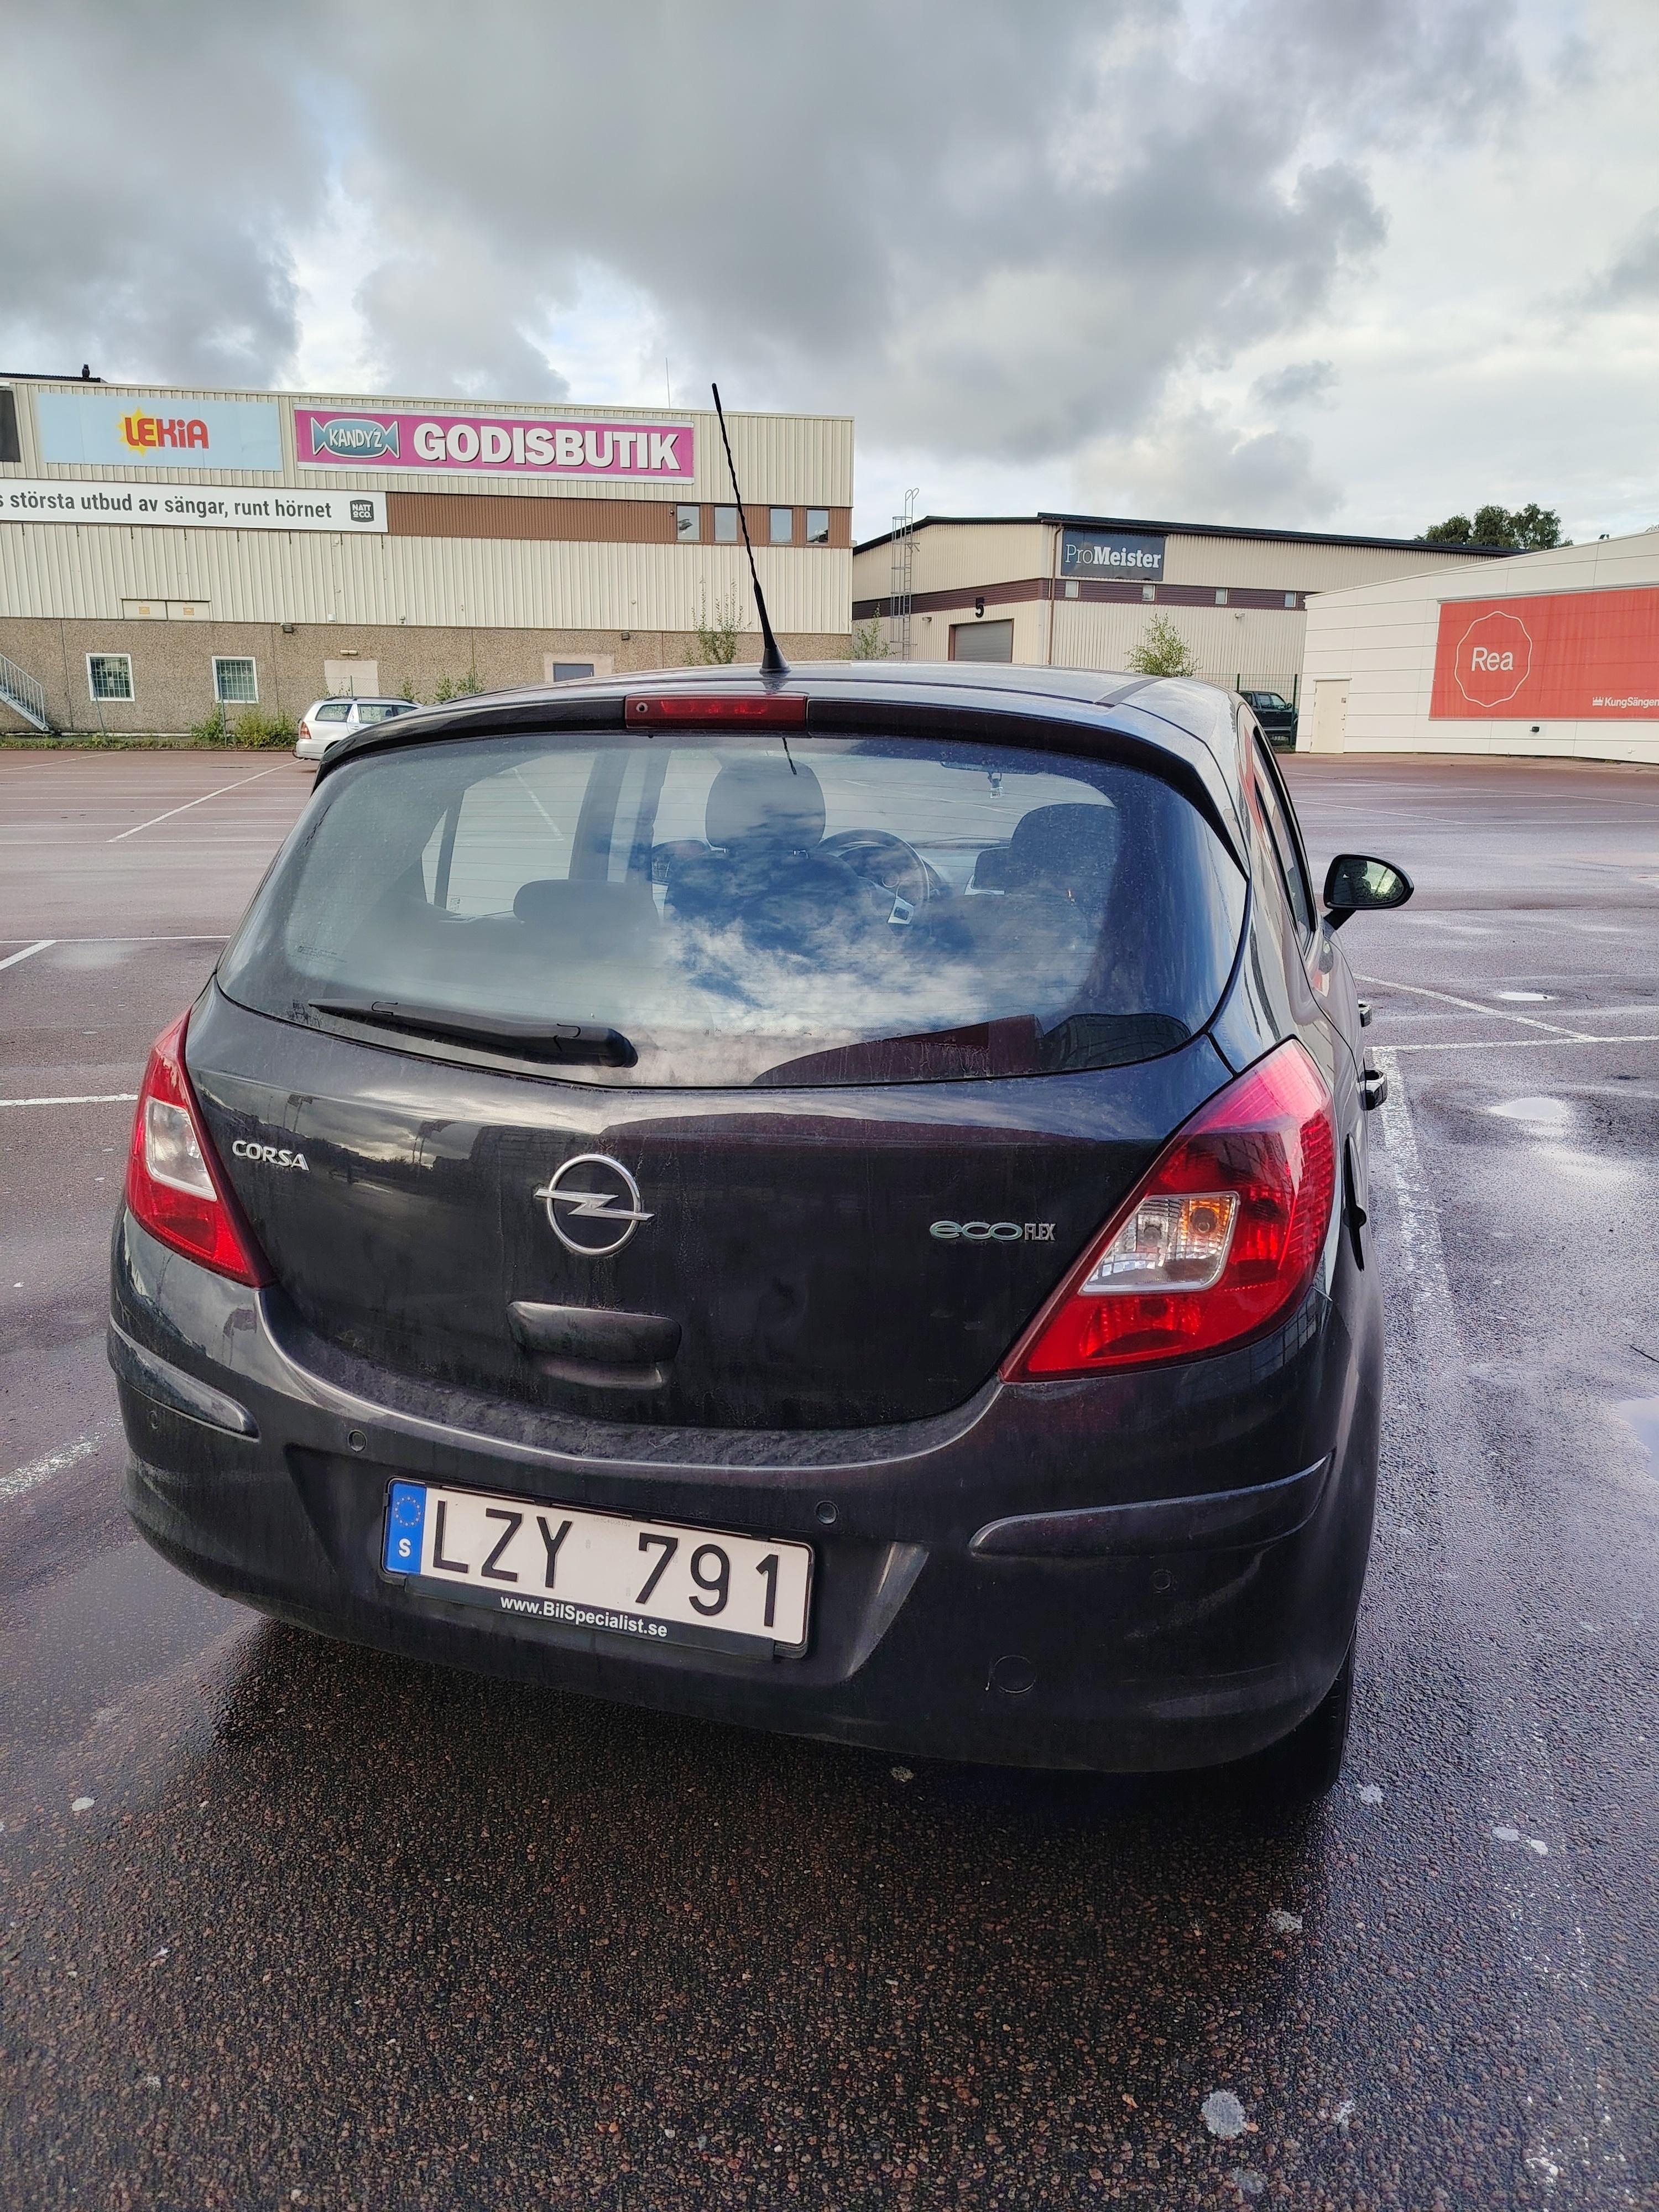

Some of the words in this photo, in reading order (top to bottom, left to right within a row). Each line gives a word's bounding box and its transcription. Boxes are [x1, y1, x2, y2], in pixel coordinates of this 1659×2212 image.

[413, 422, 681, 470] GODISBUTIK
[11, 491, 75, 509] största
[81, 493, 132, 511] utbud
[139, 498, 158, 512] av
[165, 496, 228, 518] sängar,
[234, 500, 269, 517] runt
[275, 499, 331, 518] hörnet
[1065, 544, 1161, 568] ProMeister
[975, 597, 984, 618] 5
[1472, 647, 1513, 671] Rea
[1605, 697, 1659, 708] KungSängen
[232, 1140, 310, 1171] CORSA
[398, 1538, 411, 1557] S
[433, 1500, 572, 1588] LZY
[635, 1532, 778, 1627] 791
[500, 1596, 667, 1637] www.BilSpecialist.se
